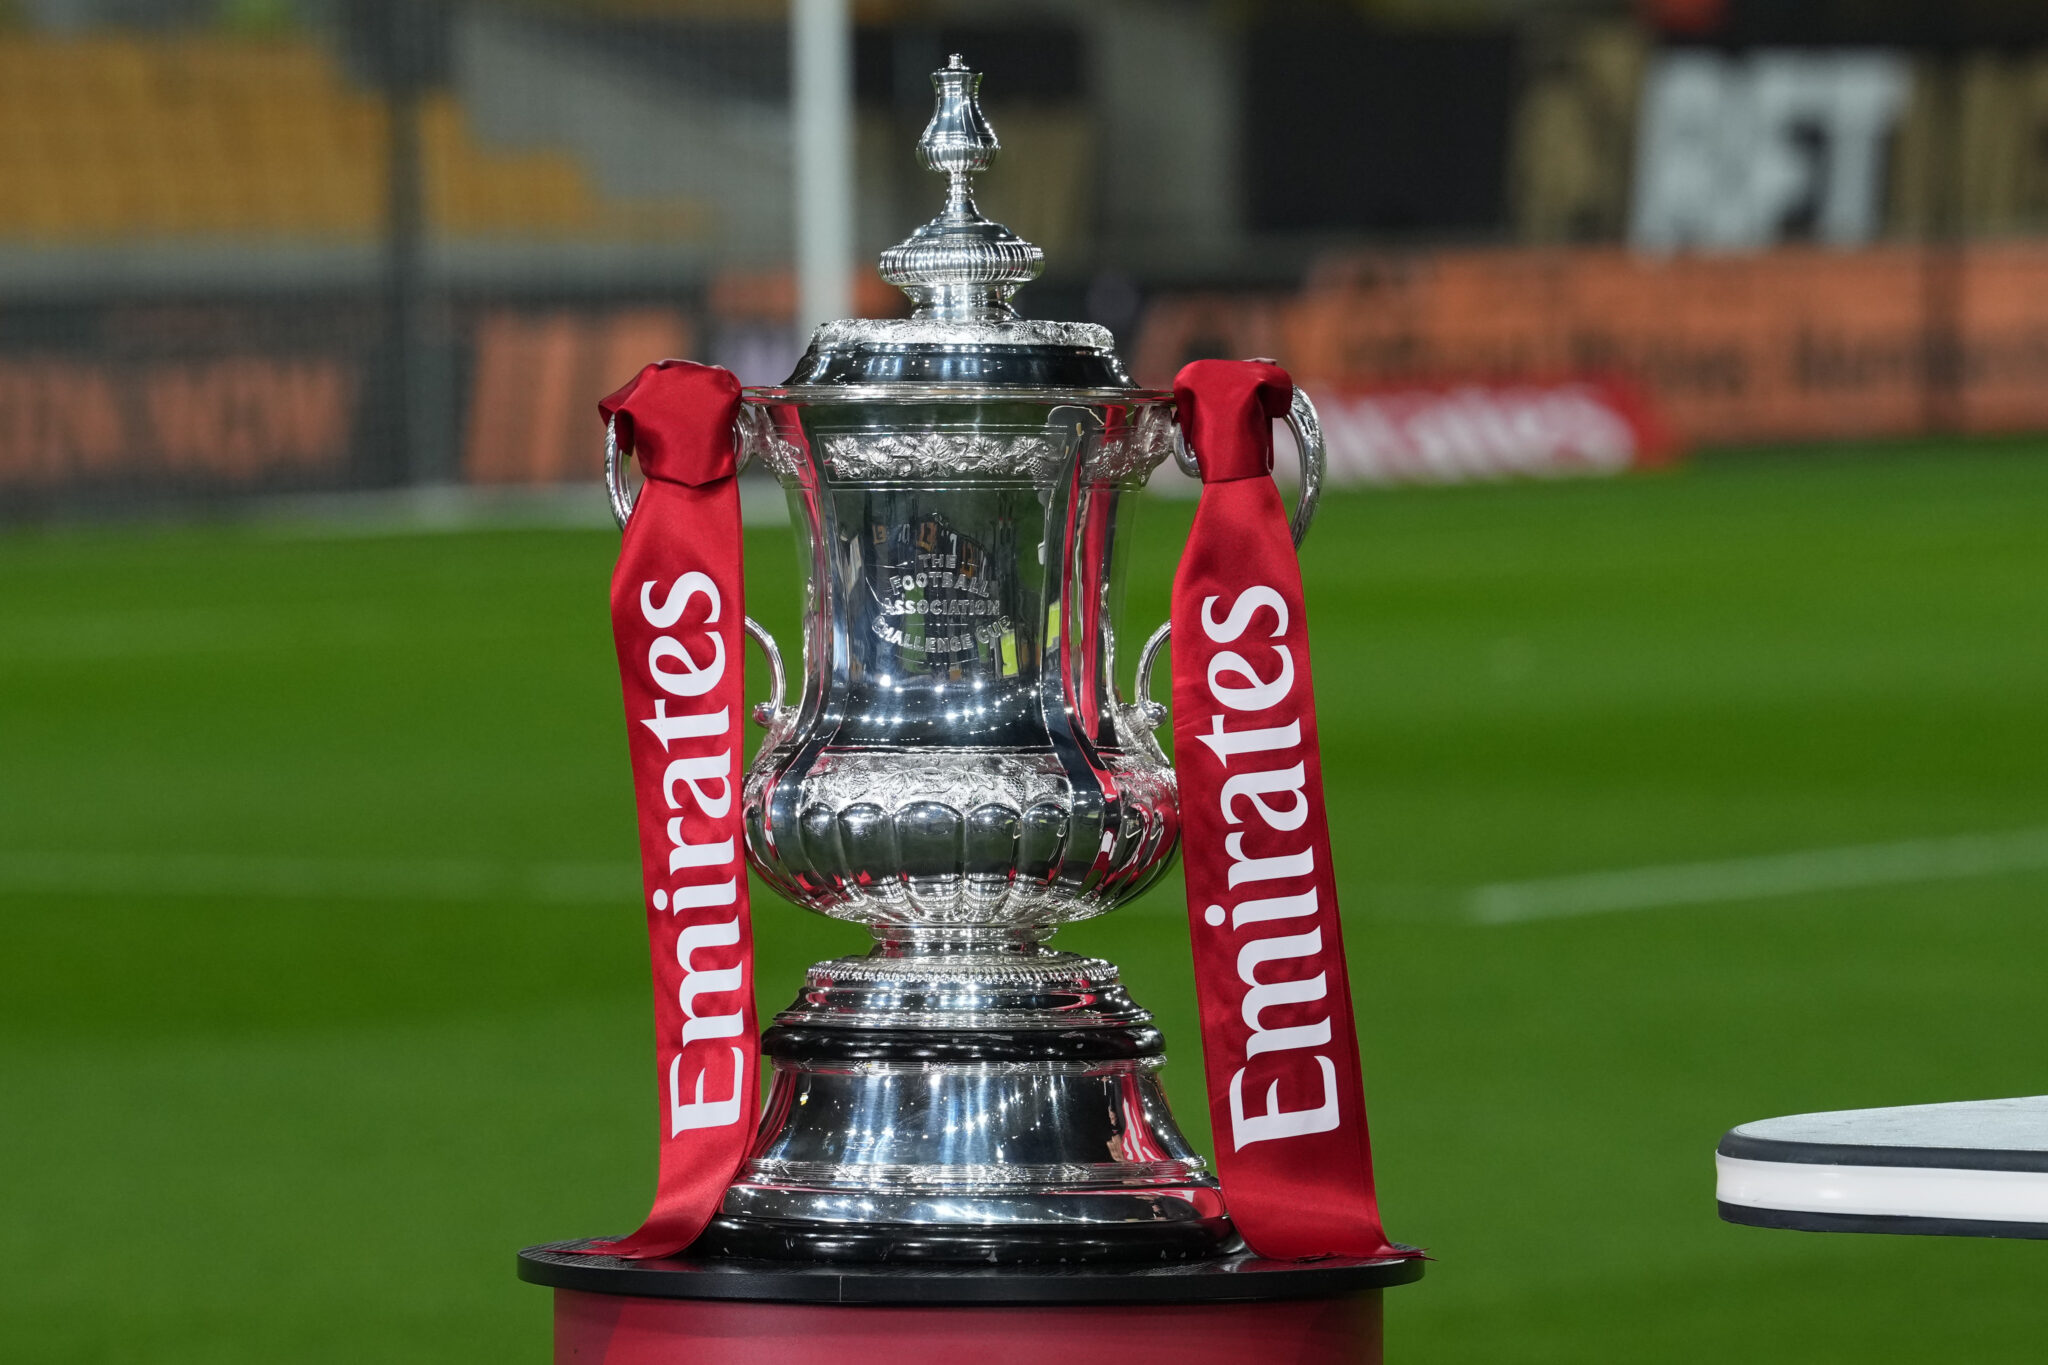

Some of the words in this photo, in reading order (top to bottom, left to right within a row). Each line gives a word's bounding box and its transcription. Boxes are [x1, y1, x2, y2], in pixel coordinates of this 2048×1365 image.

[918, 553, 958, 569] THE
[889, 571, 990, 599] FOOTBALL
[880, 597, 1001, 617] ASSOCIATION
[871, 615, 974, 654] CHALLENGE
[975, 615, 1012, 644] CUP
[641, 571, 744, 1139] Emirates
[1195, 585, 1340, 1153] Emirates
